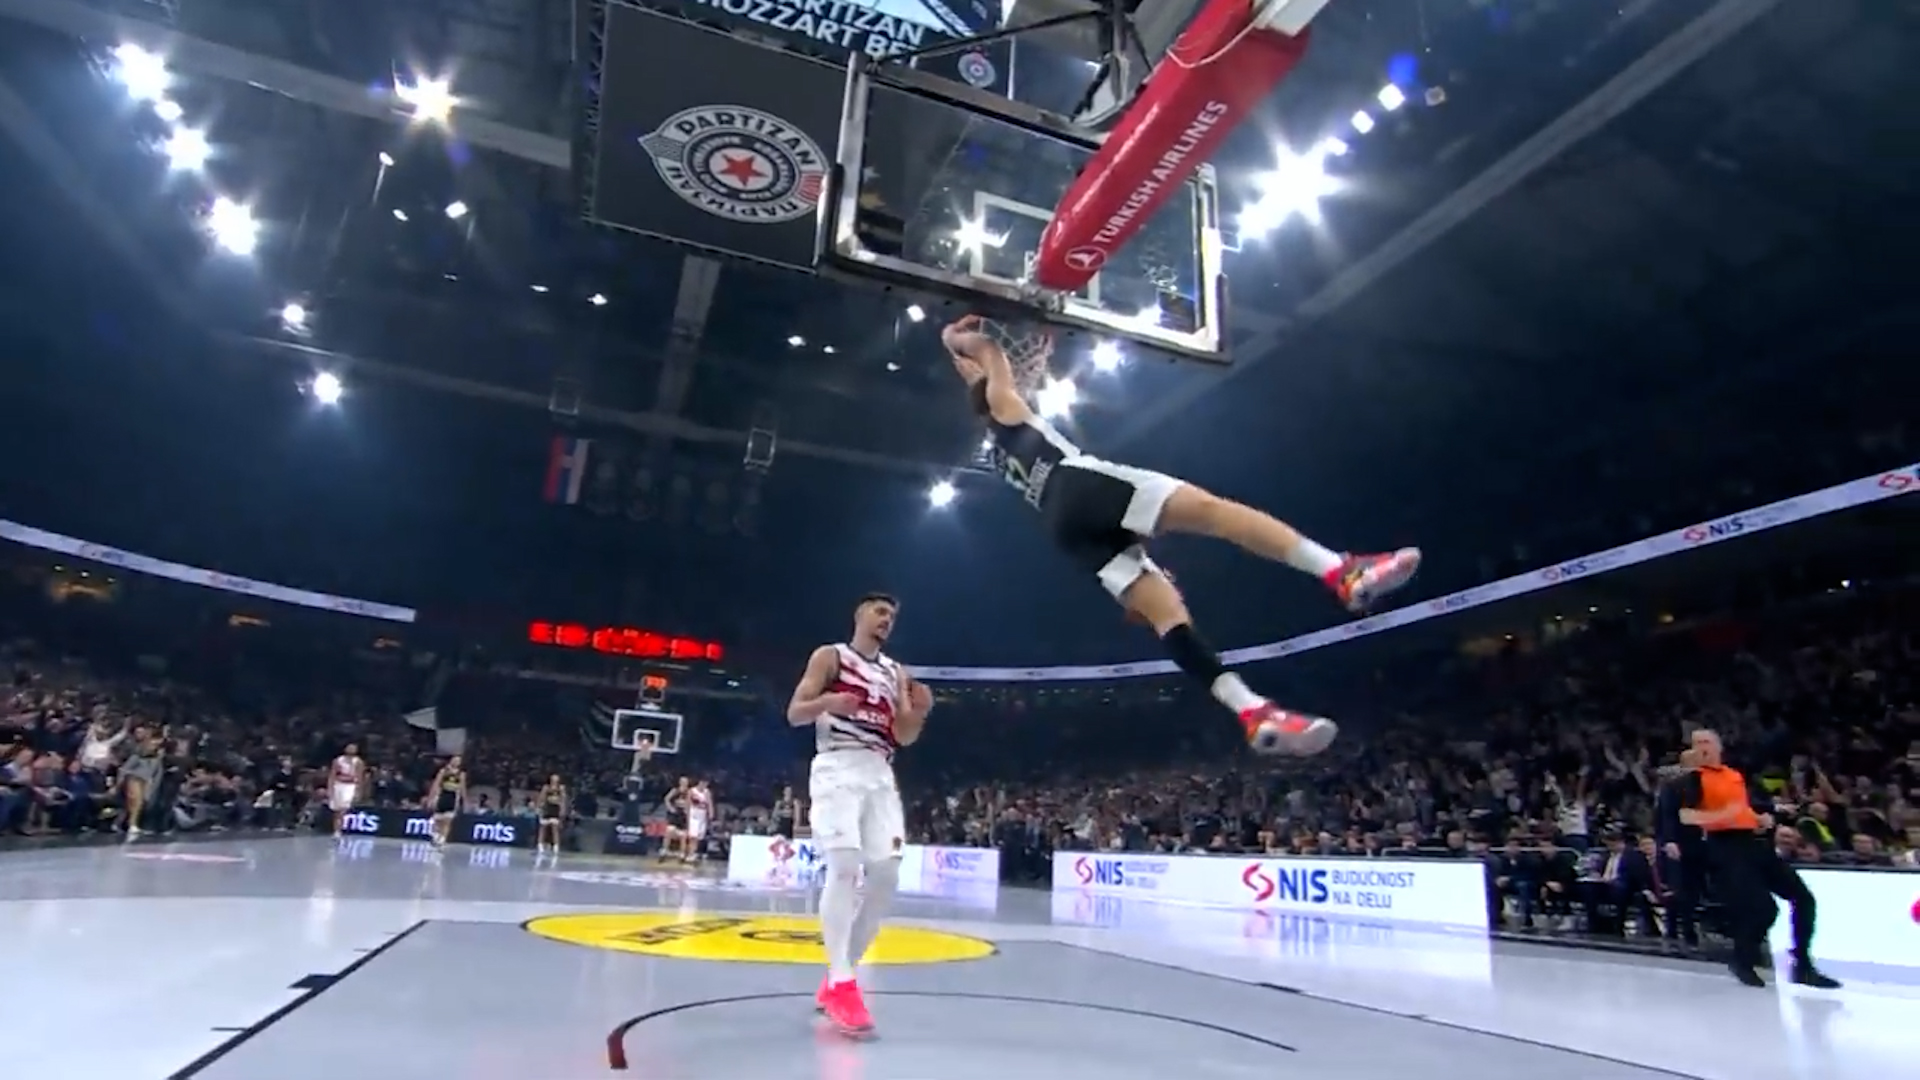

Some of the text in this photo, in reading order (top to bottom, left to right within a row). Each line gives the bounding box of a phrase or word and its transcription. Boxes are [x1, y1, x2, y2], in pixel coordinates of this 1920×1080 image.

[698, 0, 861, 47] OZZART
[674, 112, 816, 166] PARTIZAN
[1092, 101, 1228, 243] TURKISH AIRLINES
[1708, 516, 1744, 537] NIS
[405, 816, 435, 835] mt
[473, 821, 515, 842] mts
[1095, 859, 1123, 885] NIS
[1279, 868, 1328, 903] NIS
[1333, 891, 1392, 908] NA DELU
